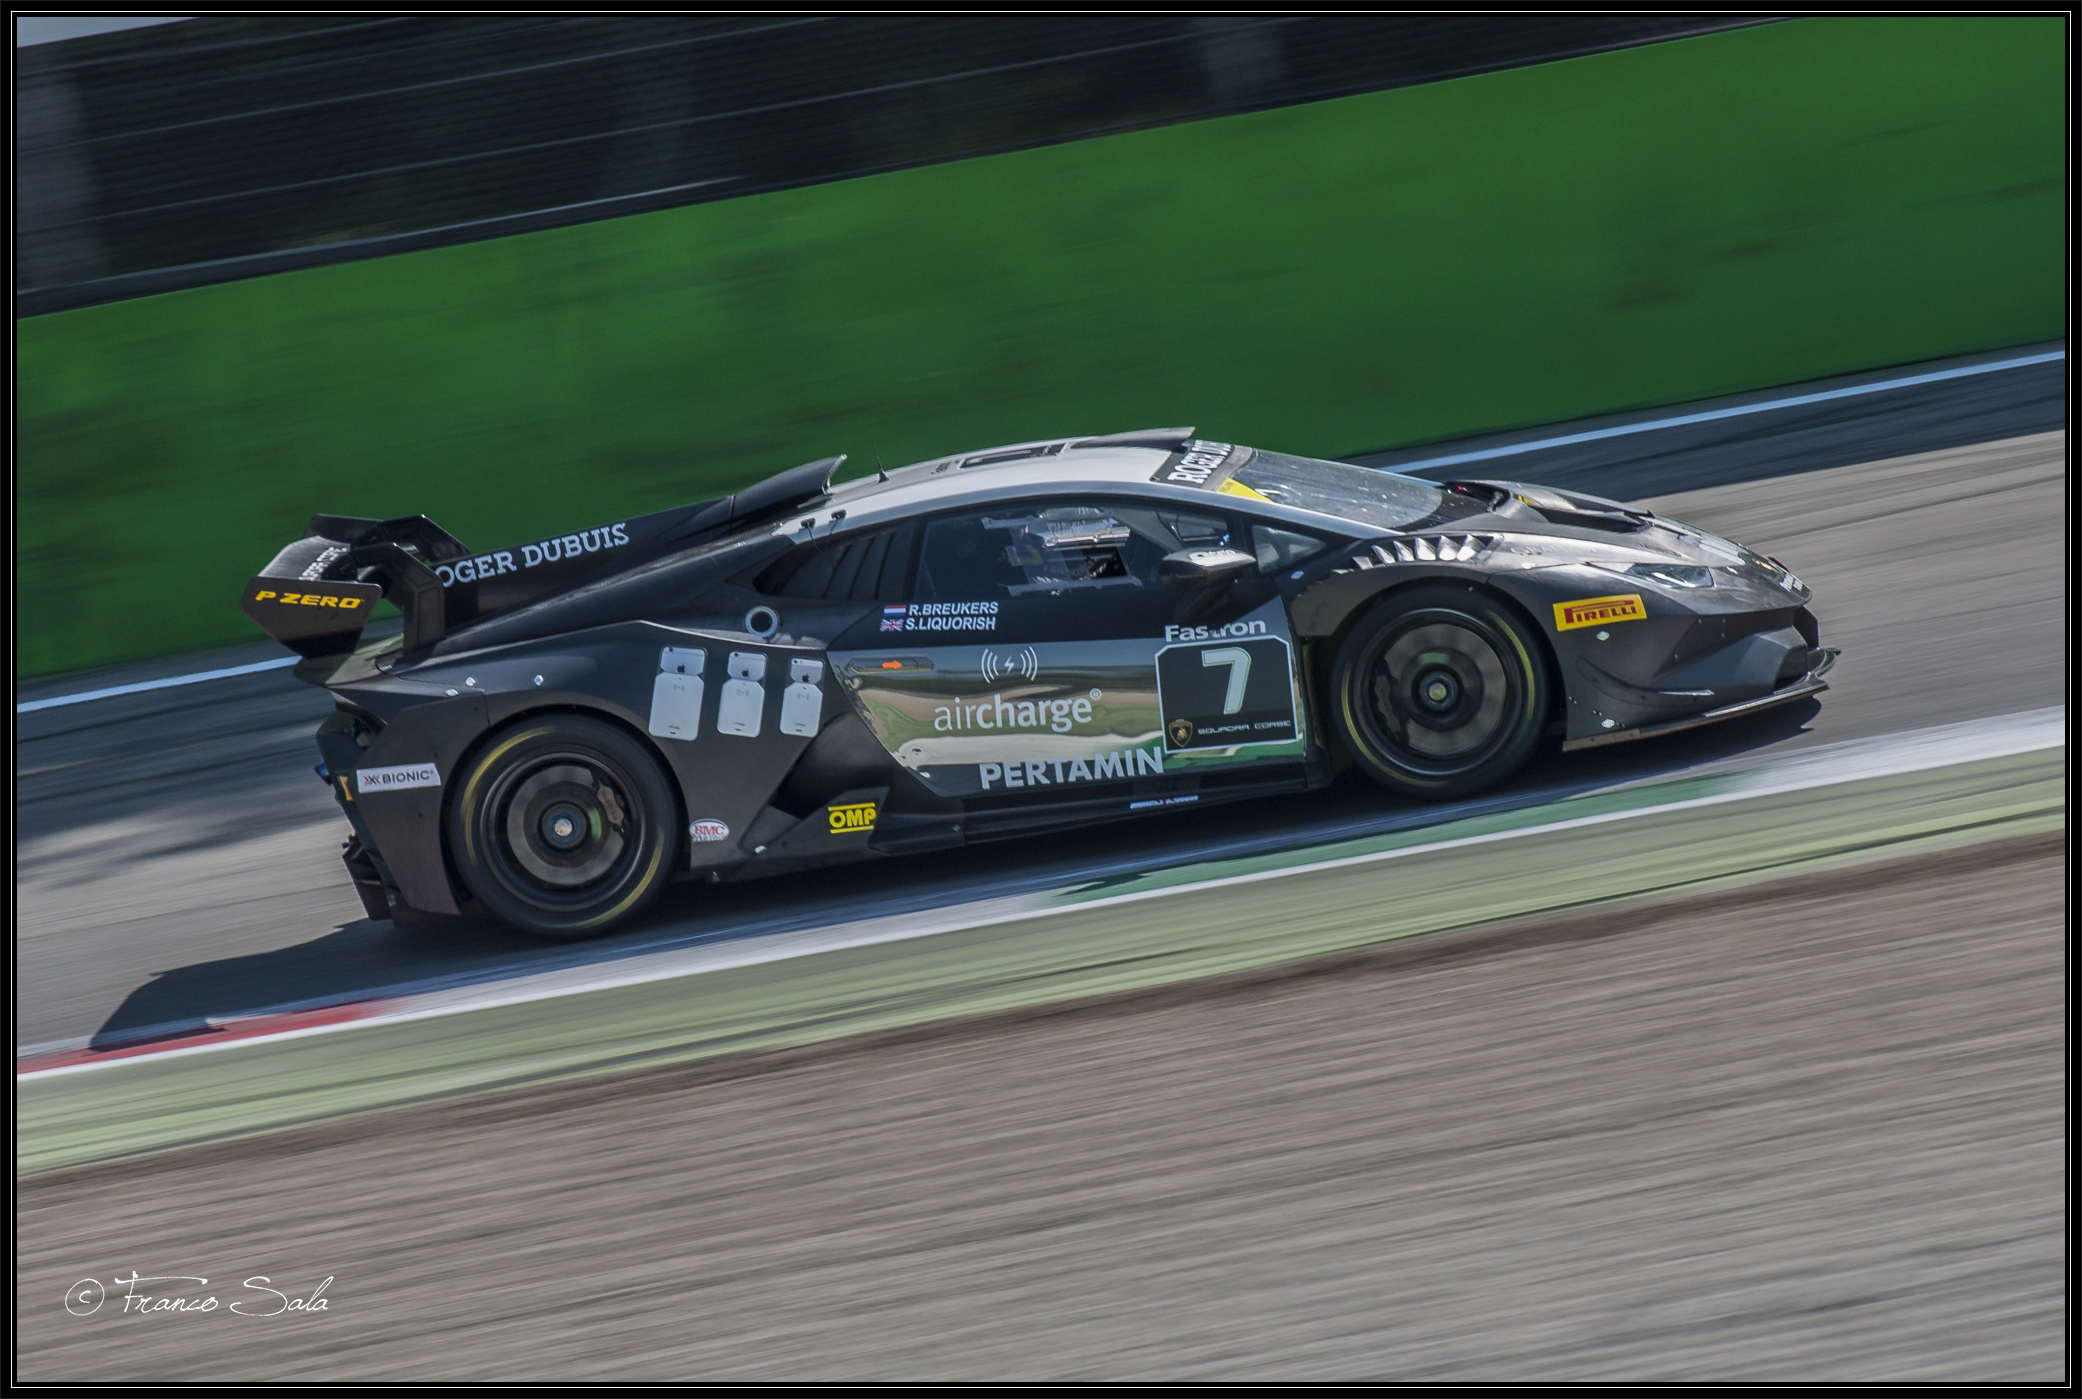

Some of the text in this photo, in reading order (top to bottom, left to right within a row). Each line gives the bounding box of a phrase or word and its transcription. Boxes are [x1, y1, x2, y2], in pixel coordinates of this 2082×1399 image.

[435, 522, 630, 588] OGER DUBUIS
[255, 590, 361, 609] P ZERO
[908, 601, 999, 616] R.BREUKERS
[1563, 600, 1637, 624] PIRELLI
[905, 616, 996, 631] S.LIQUORISH
[1201, 646, 1252, 715] 7
[979, 746, 1164, 790] PERTAMIN
[829, 807, 877, 828] OMP
[693, 824, 725, 837] BMC
